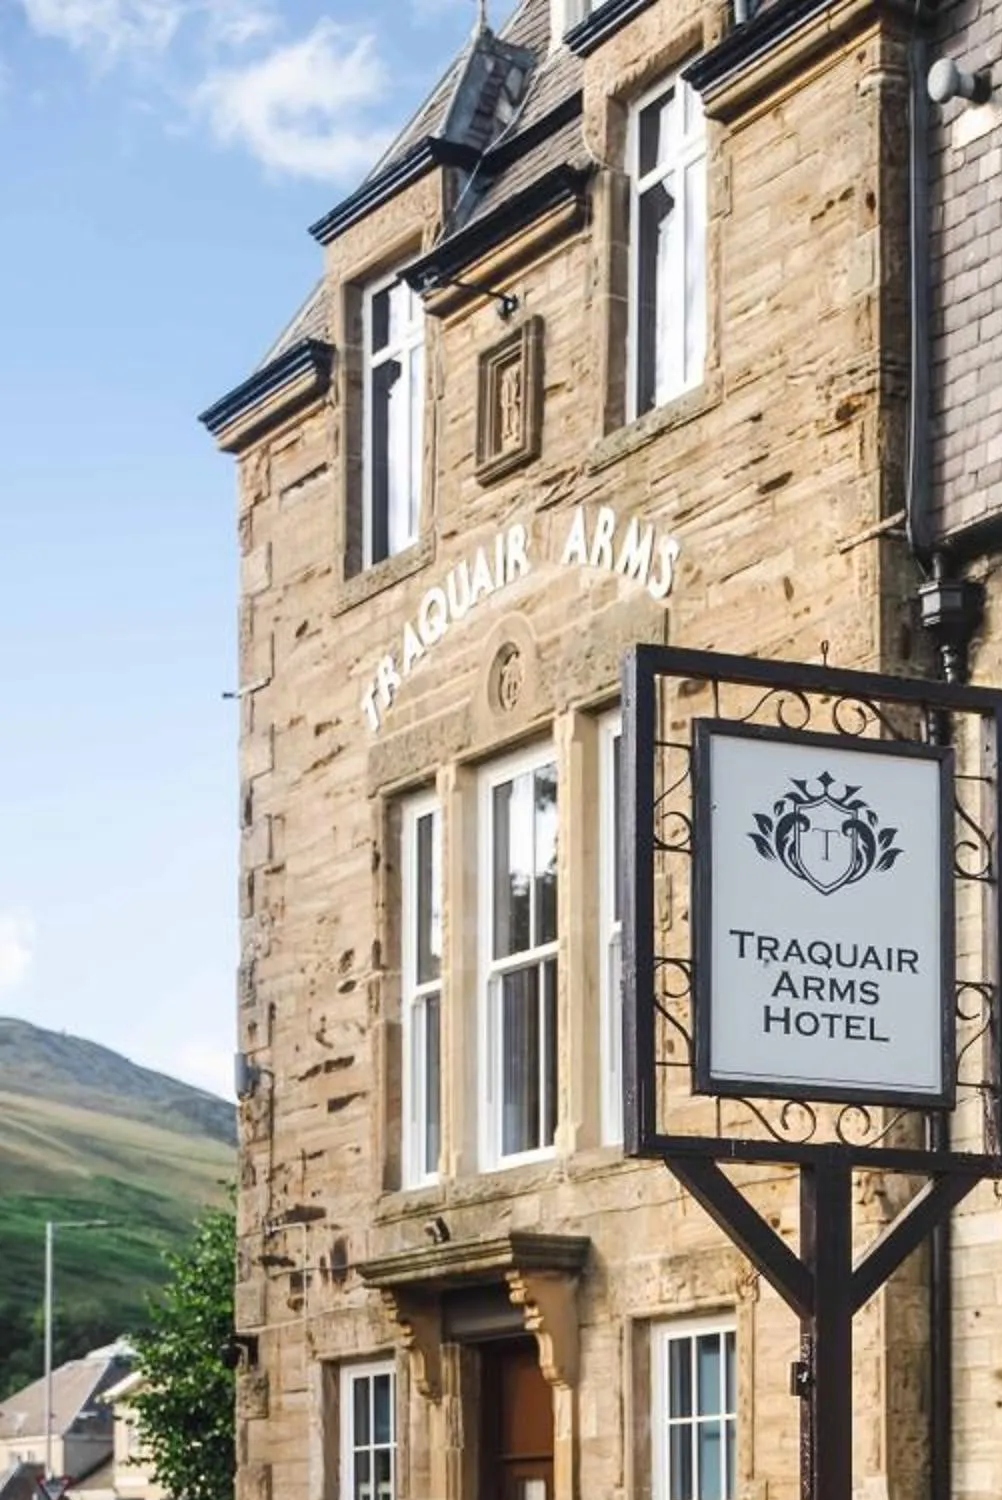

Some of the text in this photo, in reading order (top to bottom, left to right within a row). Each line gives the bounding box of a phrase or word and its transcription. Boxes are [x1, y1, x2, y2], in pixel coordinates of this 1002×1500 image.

[361, 504, 682, 733] TRAQUAIR ARMS
[812, 827, 841, 862] T
[729, 929, 920, 975] TRAQUAIR
[771, 970, 880, 1005] ARMS
[763, 1005, 891, 1042] HOTEL
